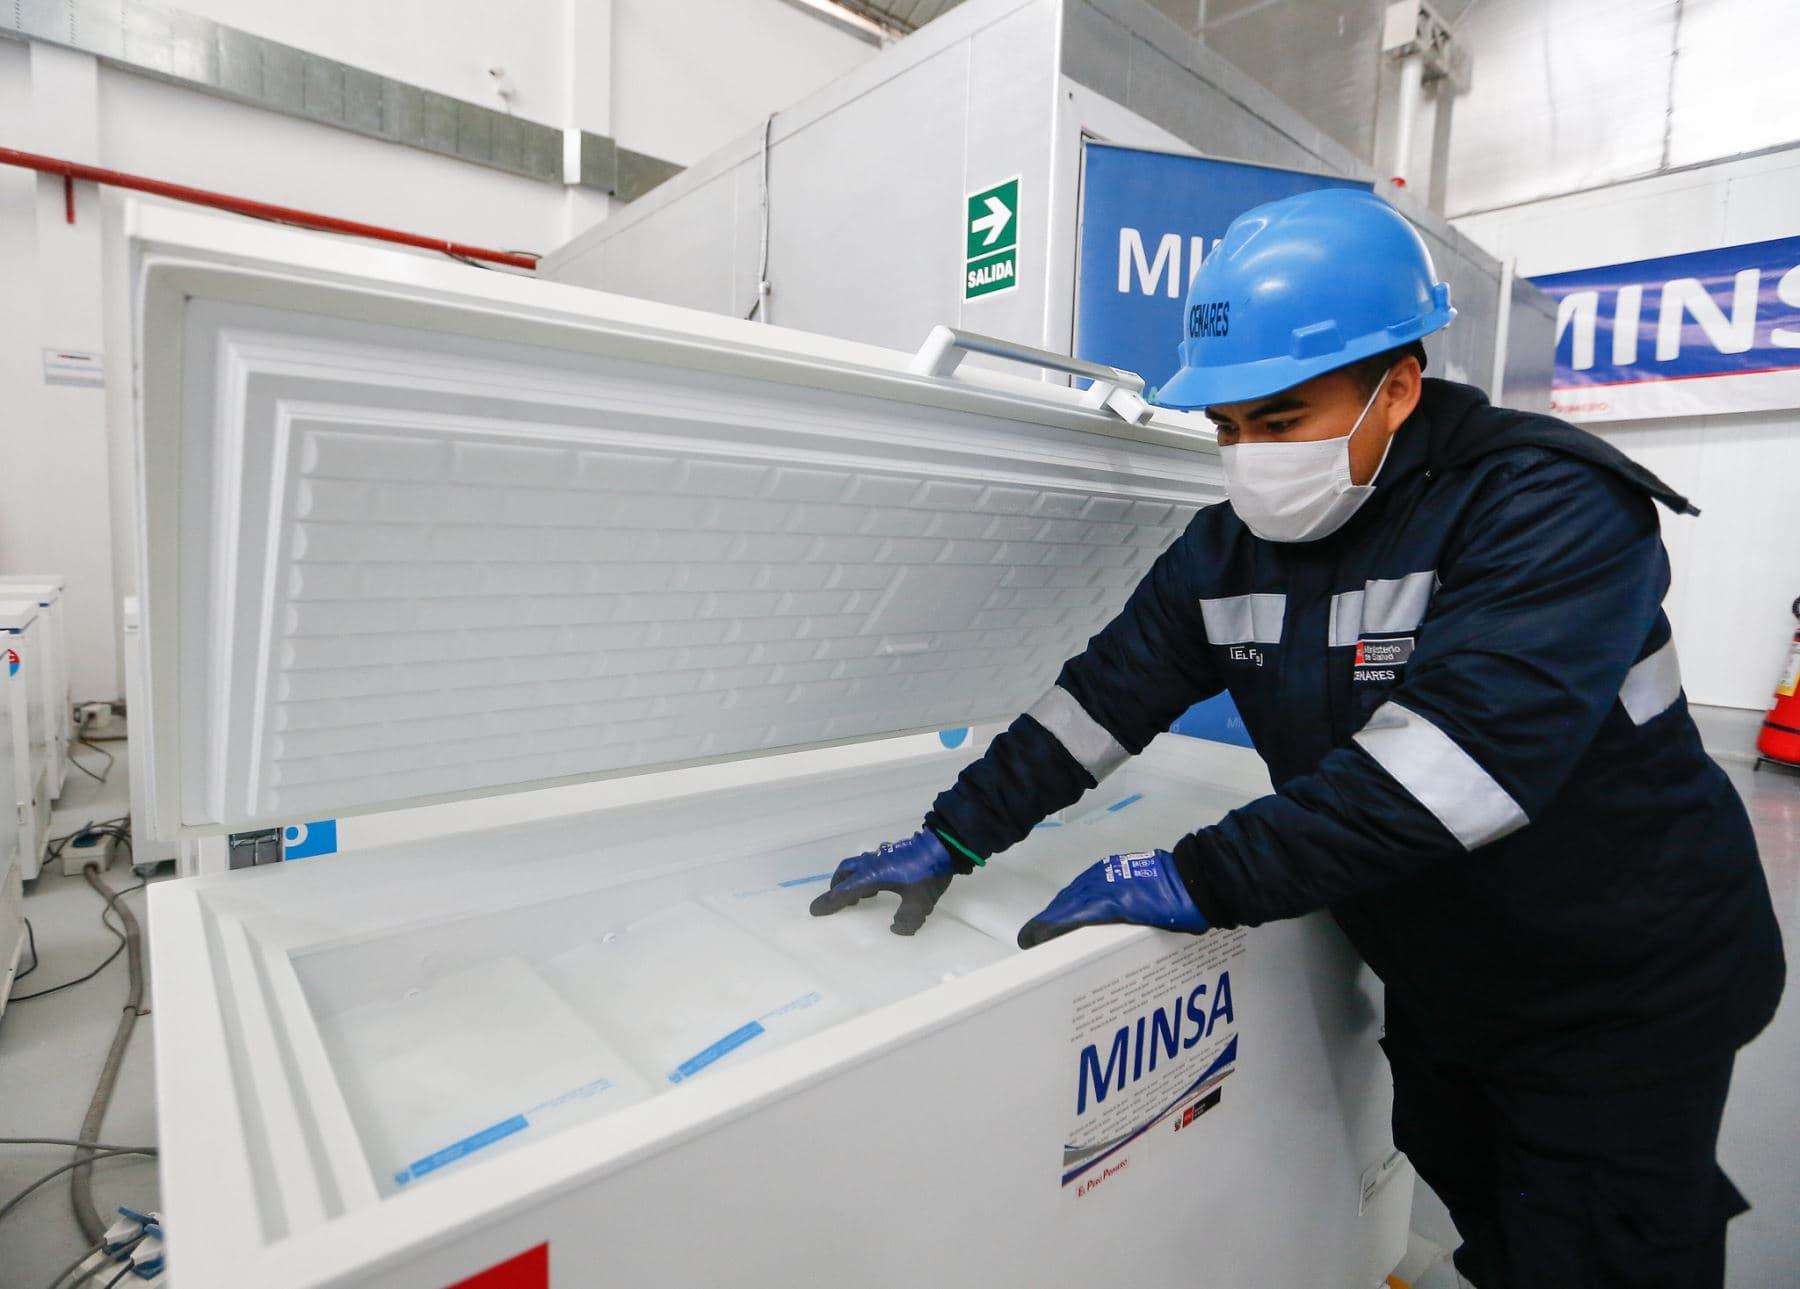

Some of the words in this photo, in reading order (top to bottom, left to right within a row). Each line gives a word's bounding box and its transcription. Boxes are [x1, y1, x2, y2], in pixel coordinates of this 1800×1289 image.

[967, 258, 1014, 289] SALIDA
[1188, 301, 1230, 338] CENARES
[1372, 653, 1394, 661] Salud
[1076, 970, 1235, 1116] MINSA
